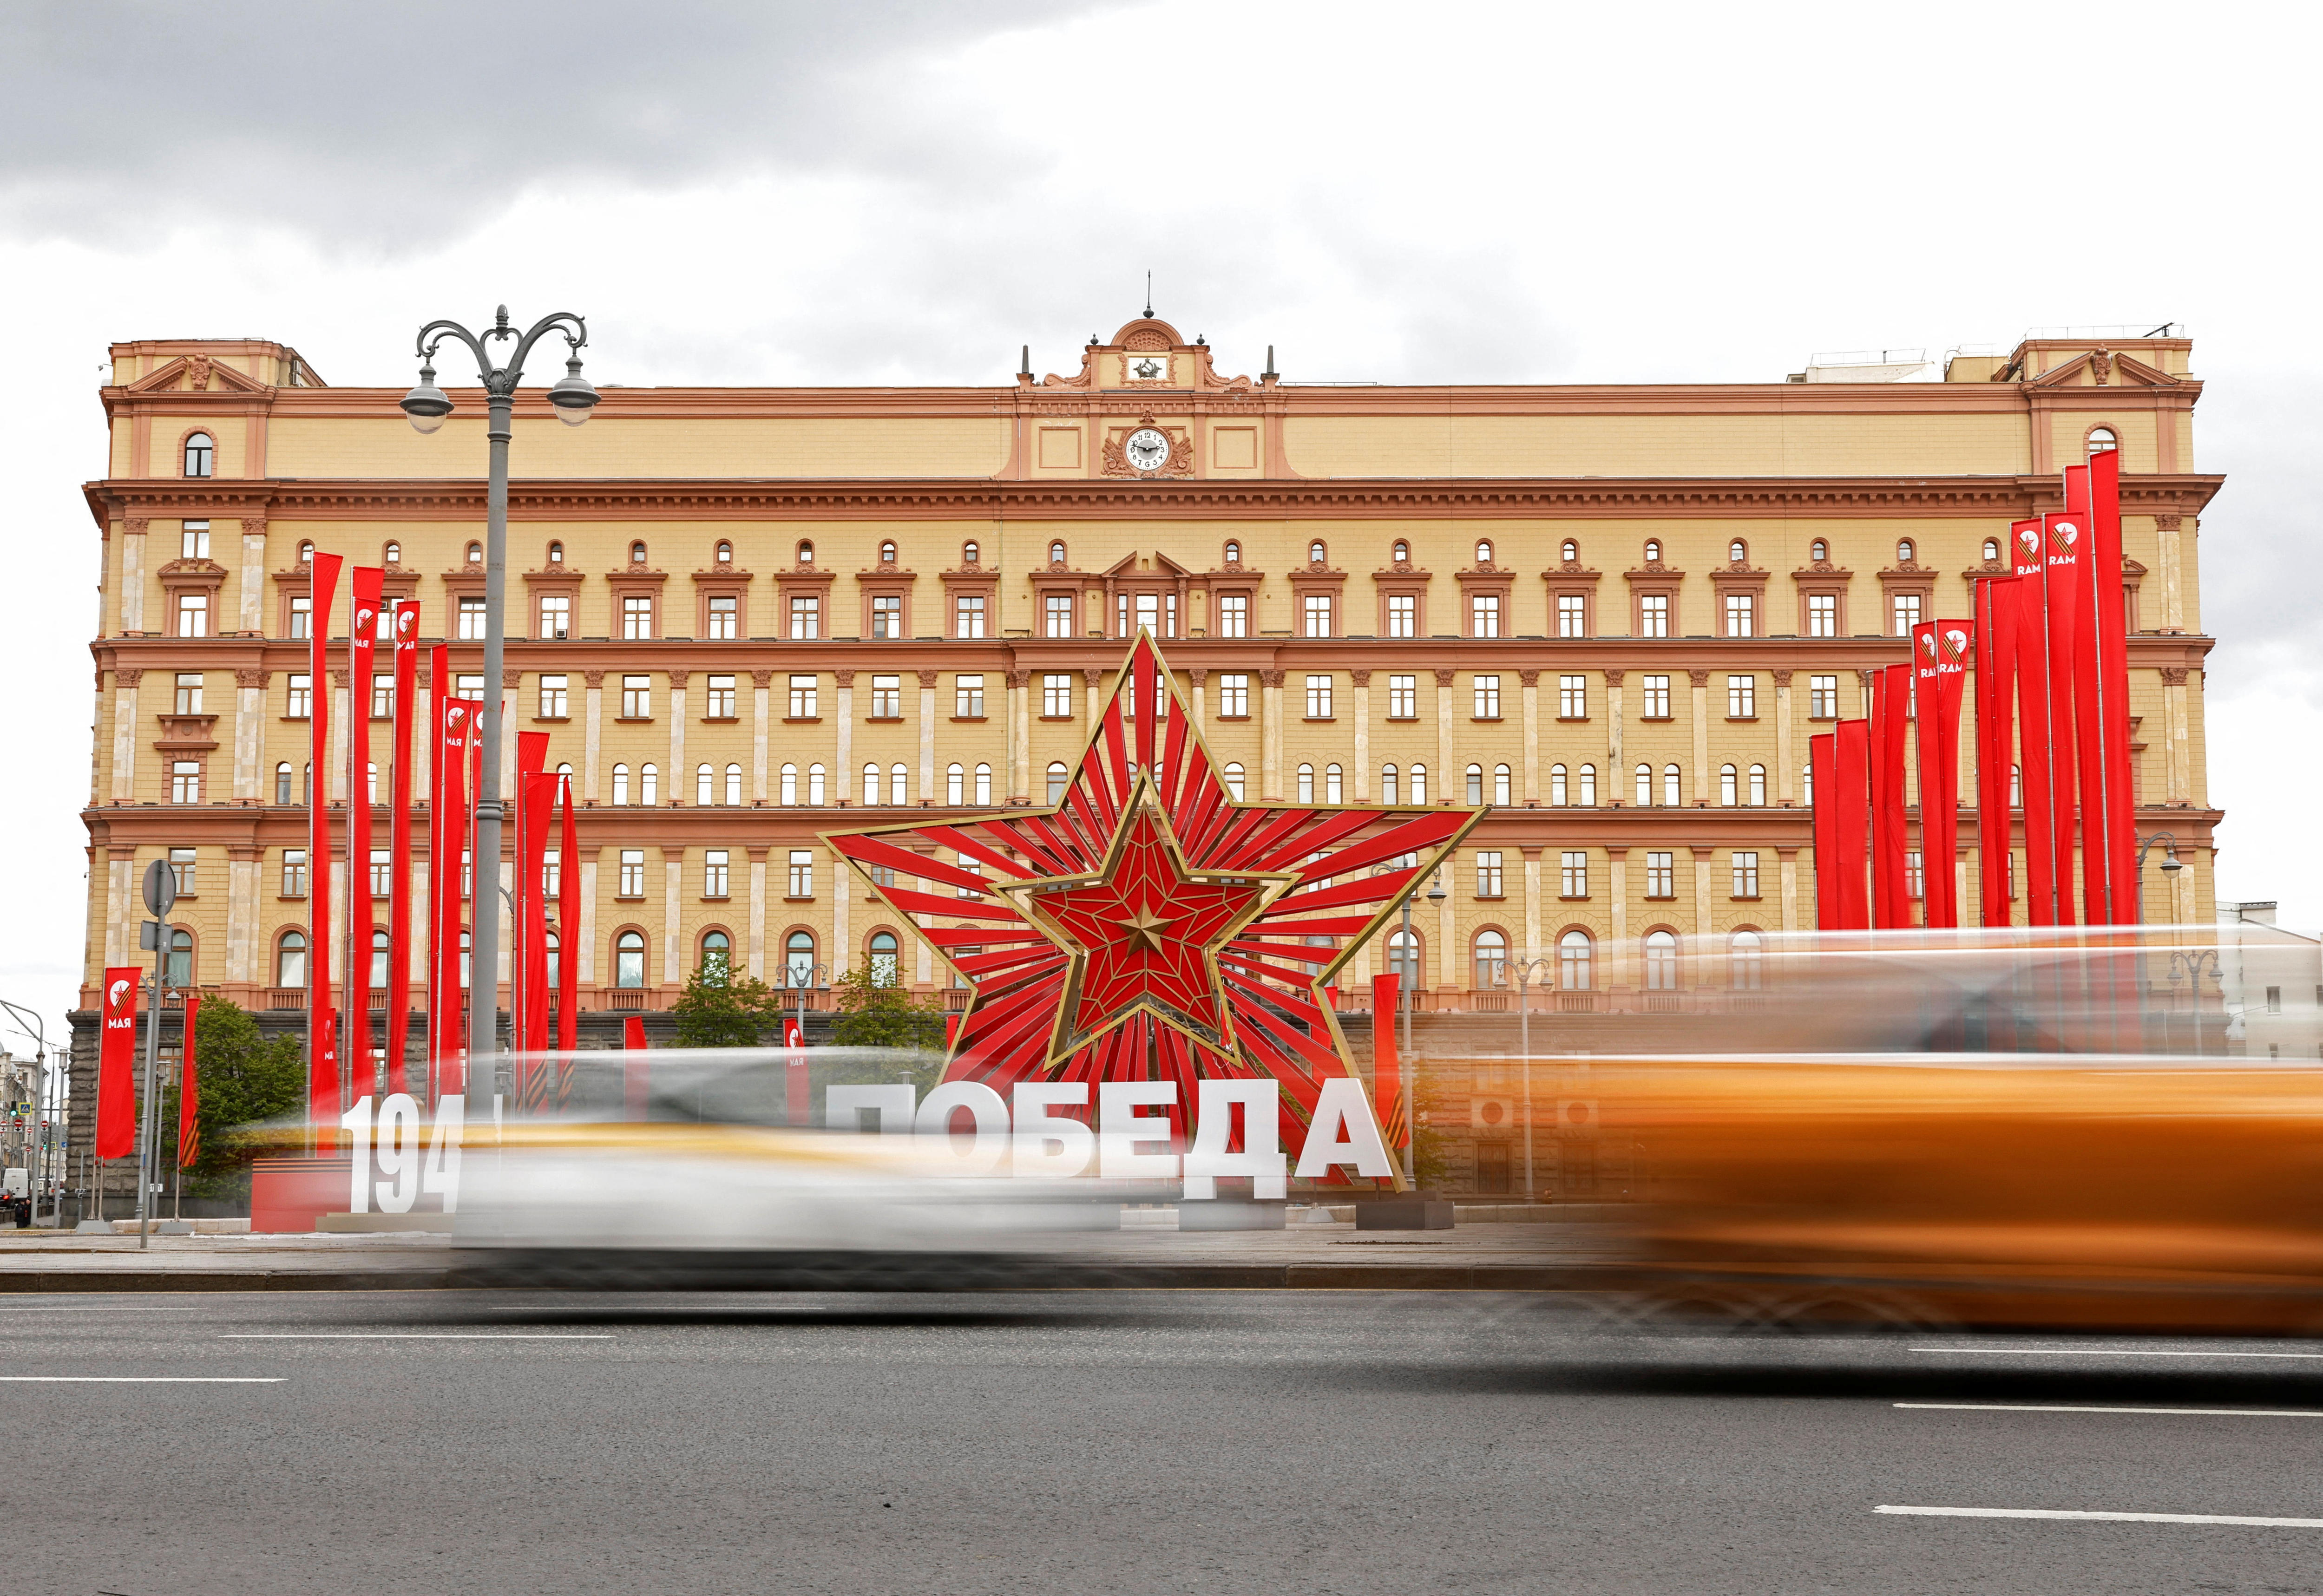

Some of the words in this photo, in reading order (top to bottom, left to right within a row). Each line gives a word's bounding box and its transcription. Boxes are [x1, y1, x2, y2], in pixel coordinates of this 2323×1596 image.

[447, 737, 462, 746] МАЯ
[108, 1018, 131, 1028] МАЯ
[790, 1057, 804, 1066] МАЯ
[826, 1078, 1393, 1199] ПОБЕДА
[341, 1093, 503, 1213] 194
